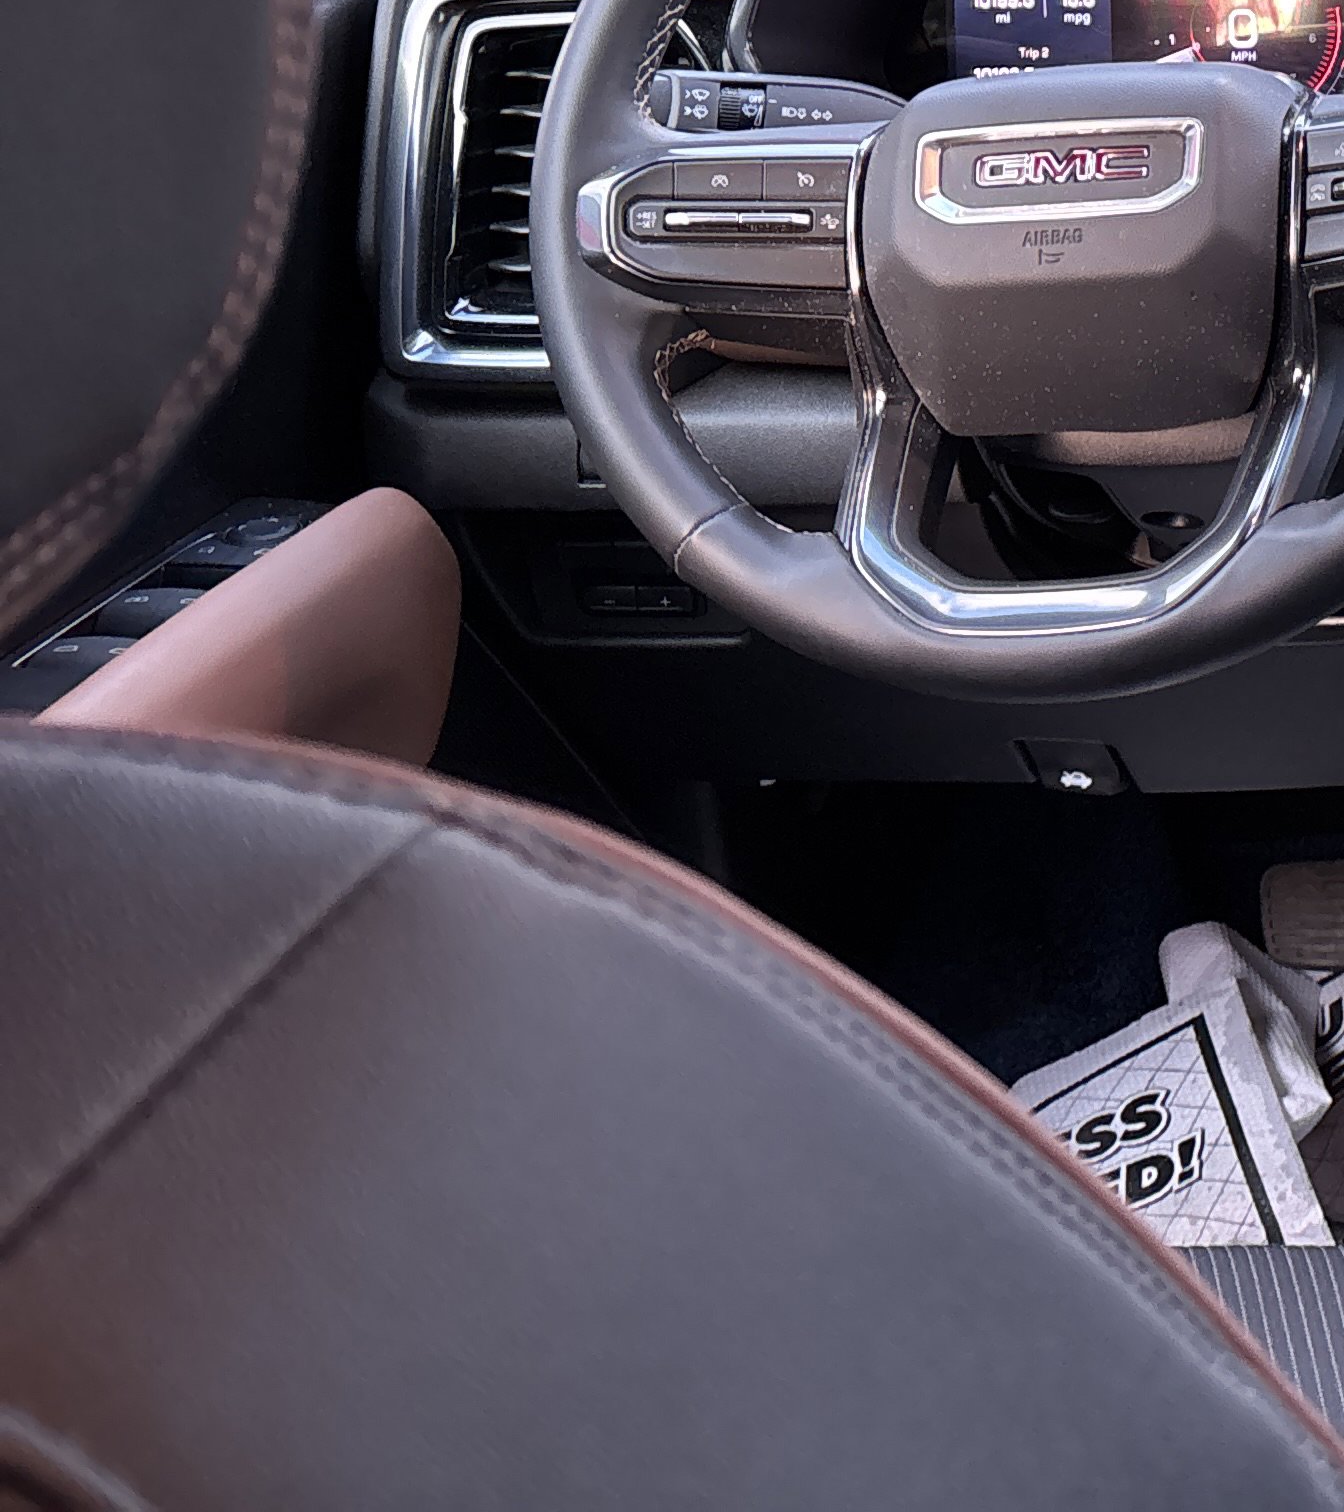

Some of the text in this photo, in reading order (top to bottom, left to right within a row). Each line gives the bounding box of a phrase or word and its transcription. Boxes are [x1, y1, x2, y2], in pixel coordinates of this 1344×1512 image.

[1063, 12, 1092, 27] mpg
[1228, 8, 1258, 49] 0
[1018, 46, 1040, 60] Trip
[1230, 50, 1257, 62] MPH
[974, 144, 1150, 188] GMC
[1022, 228, 1084, 247] AIRBAG
